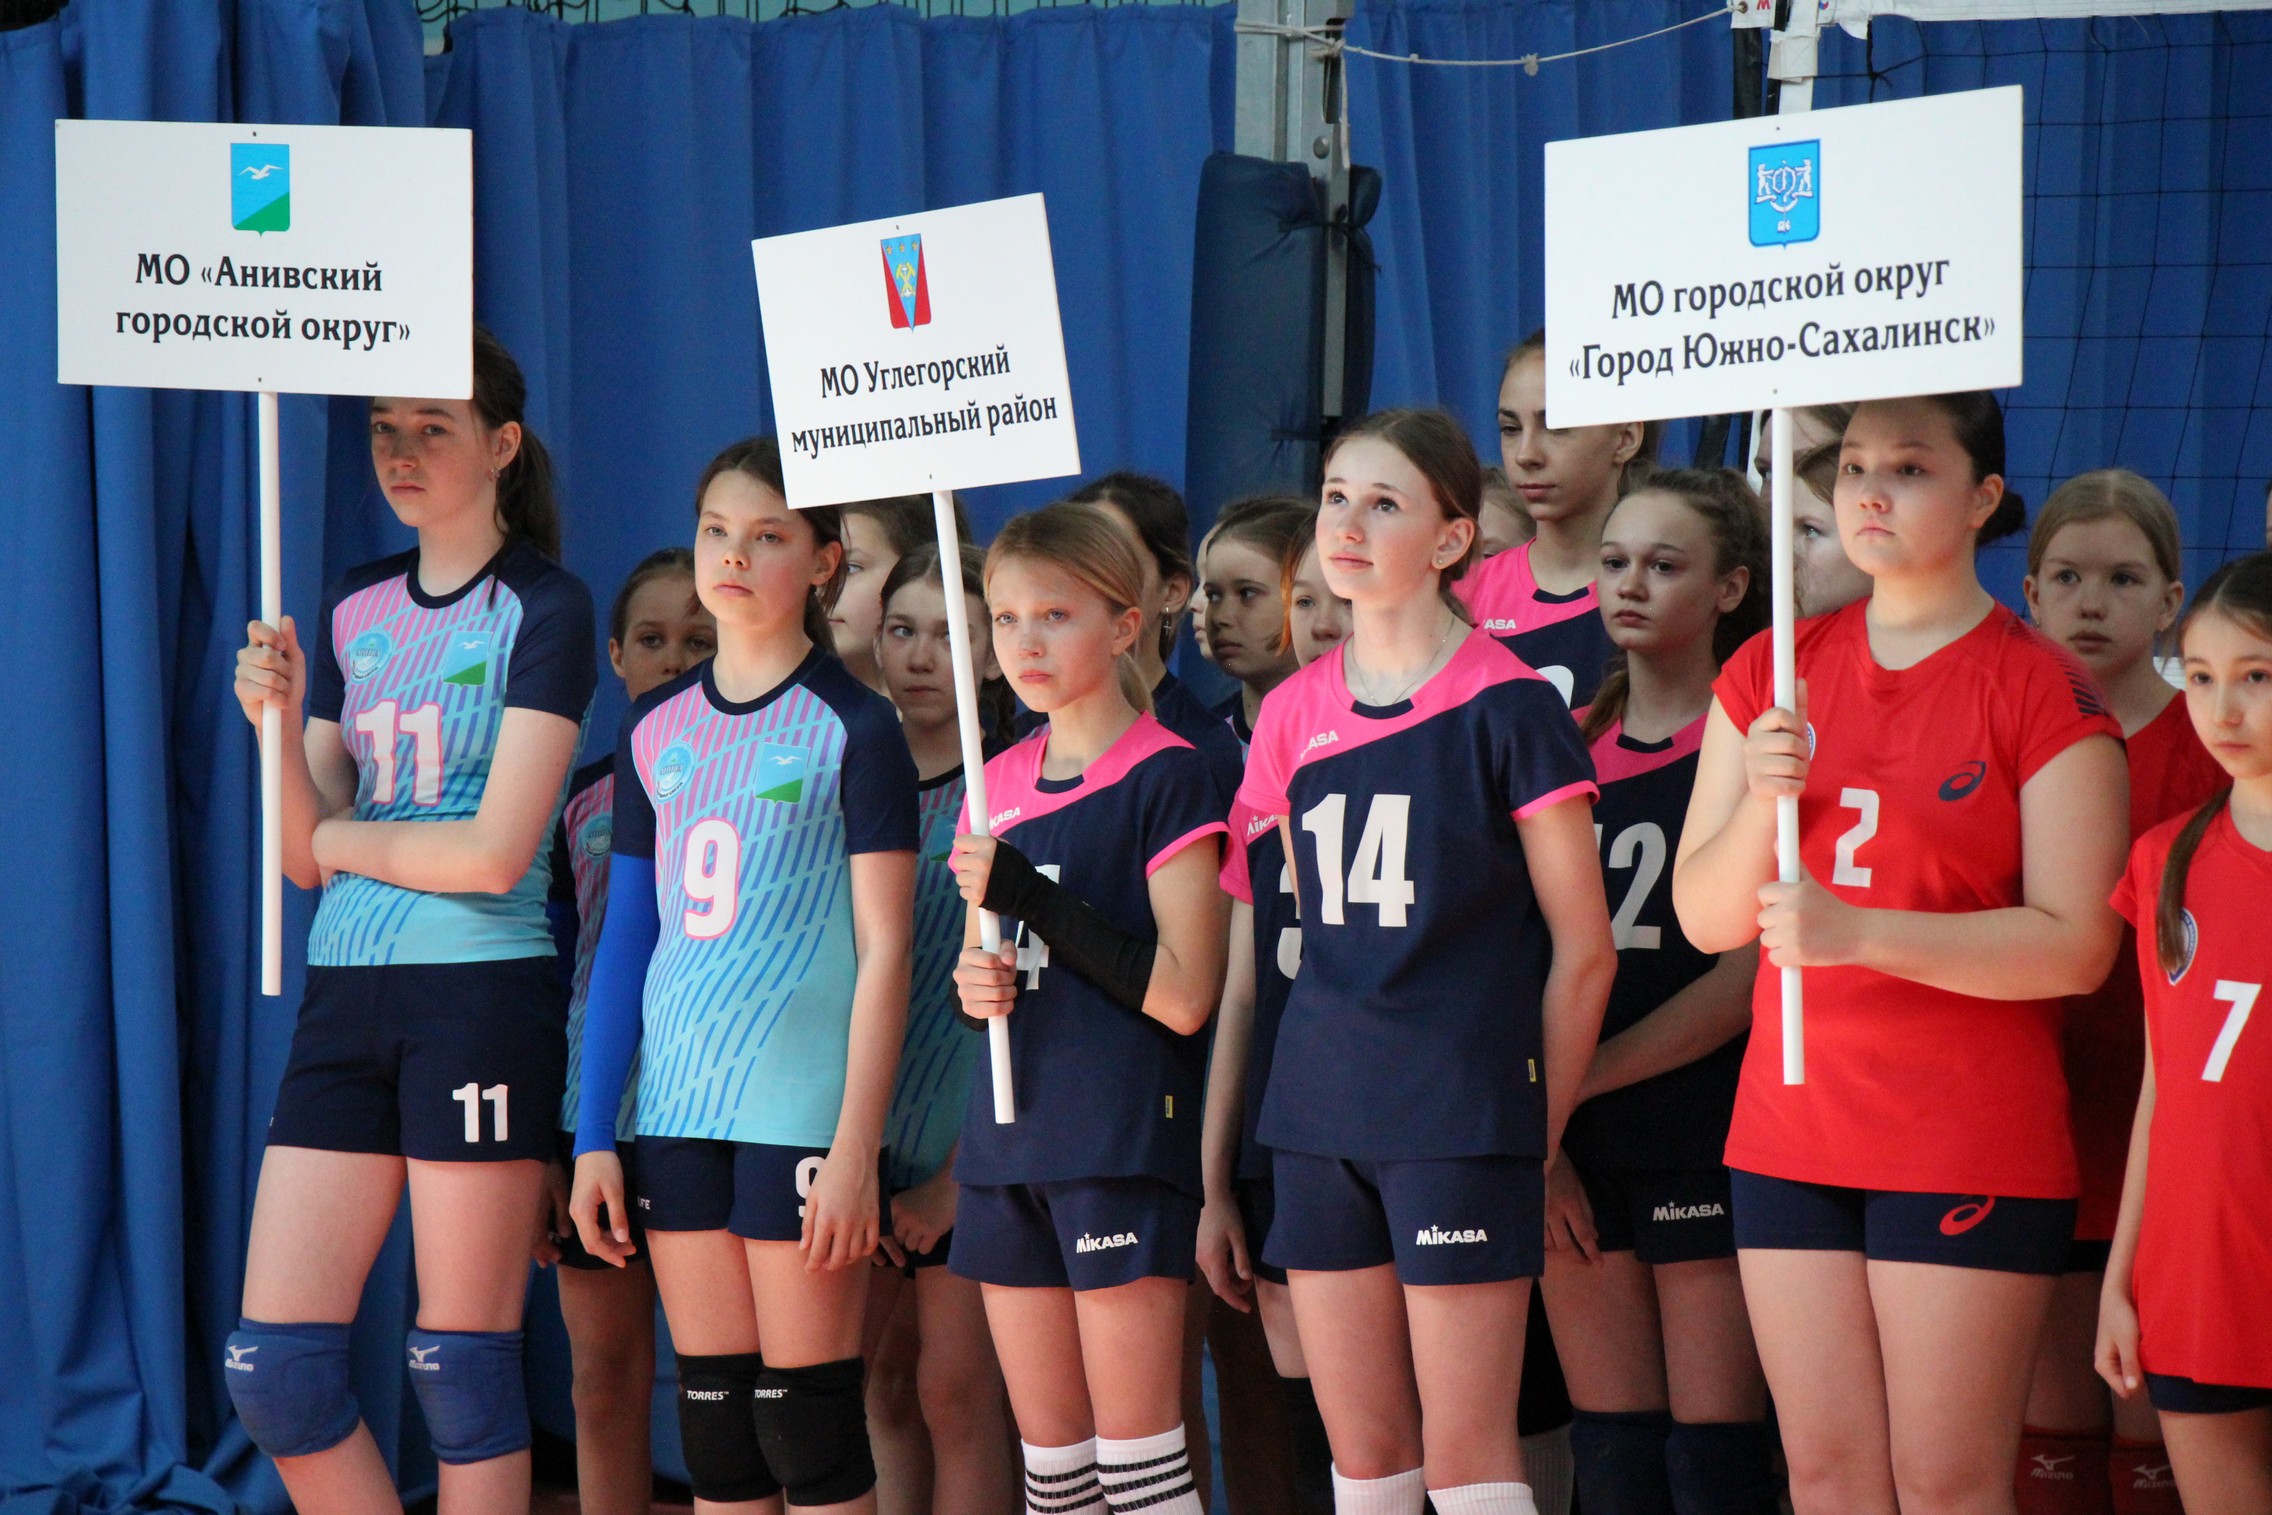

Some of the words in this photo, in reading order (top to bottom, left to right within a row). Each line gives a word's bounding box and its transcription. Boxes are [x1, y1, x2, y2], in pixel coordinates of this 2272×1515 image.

[135, 253, 191, 286] МО
[201, 255, 382, 292] «Анивский
[1611, 280, 1664, 319] МО
[1673, 262, 1845, 320] городской
[1854, 259, 1950, 300] округ
[116, 309, 292, 344] городской
[301, 318, 411, 352] округ»
[1569, 332, 1674, 387] «Город
[1683, 317, 1996, 370] Южно-Сахалинск»
[820, 364, 859, 399] МО
[863, 344, 1011, 393] Углегорский
[791, 400, 982, 460] муниципальный
[986, 394, 1058, 437] район
[355, 698, 444, 806] 11
[989, 806, 1021, 831] KASA
[1832, 787, 1880, 888] 2
[684, 816, 741, 940] 9
[1301, 793, 1415, 928] 14
[1593, 821, 1667, 951] 2
[2201, 979, 2262, 1084] 7
[452, 1082, 509, 1143] 11
